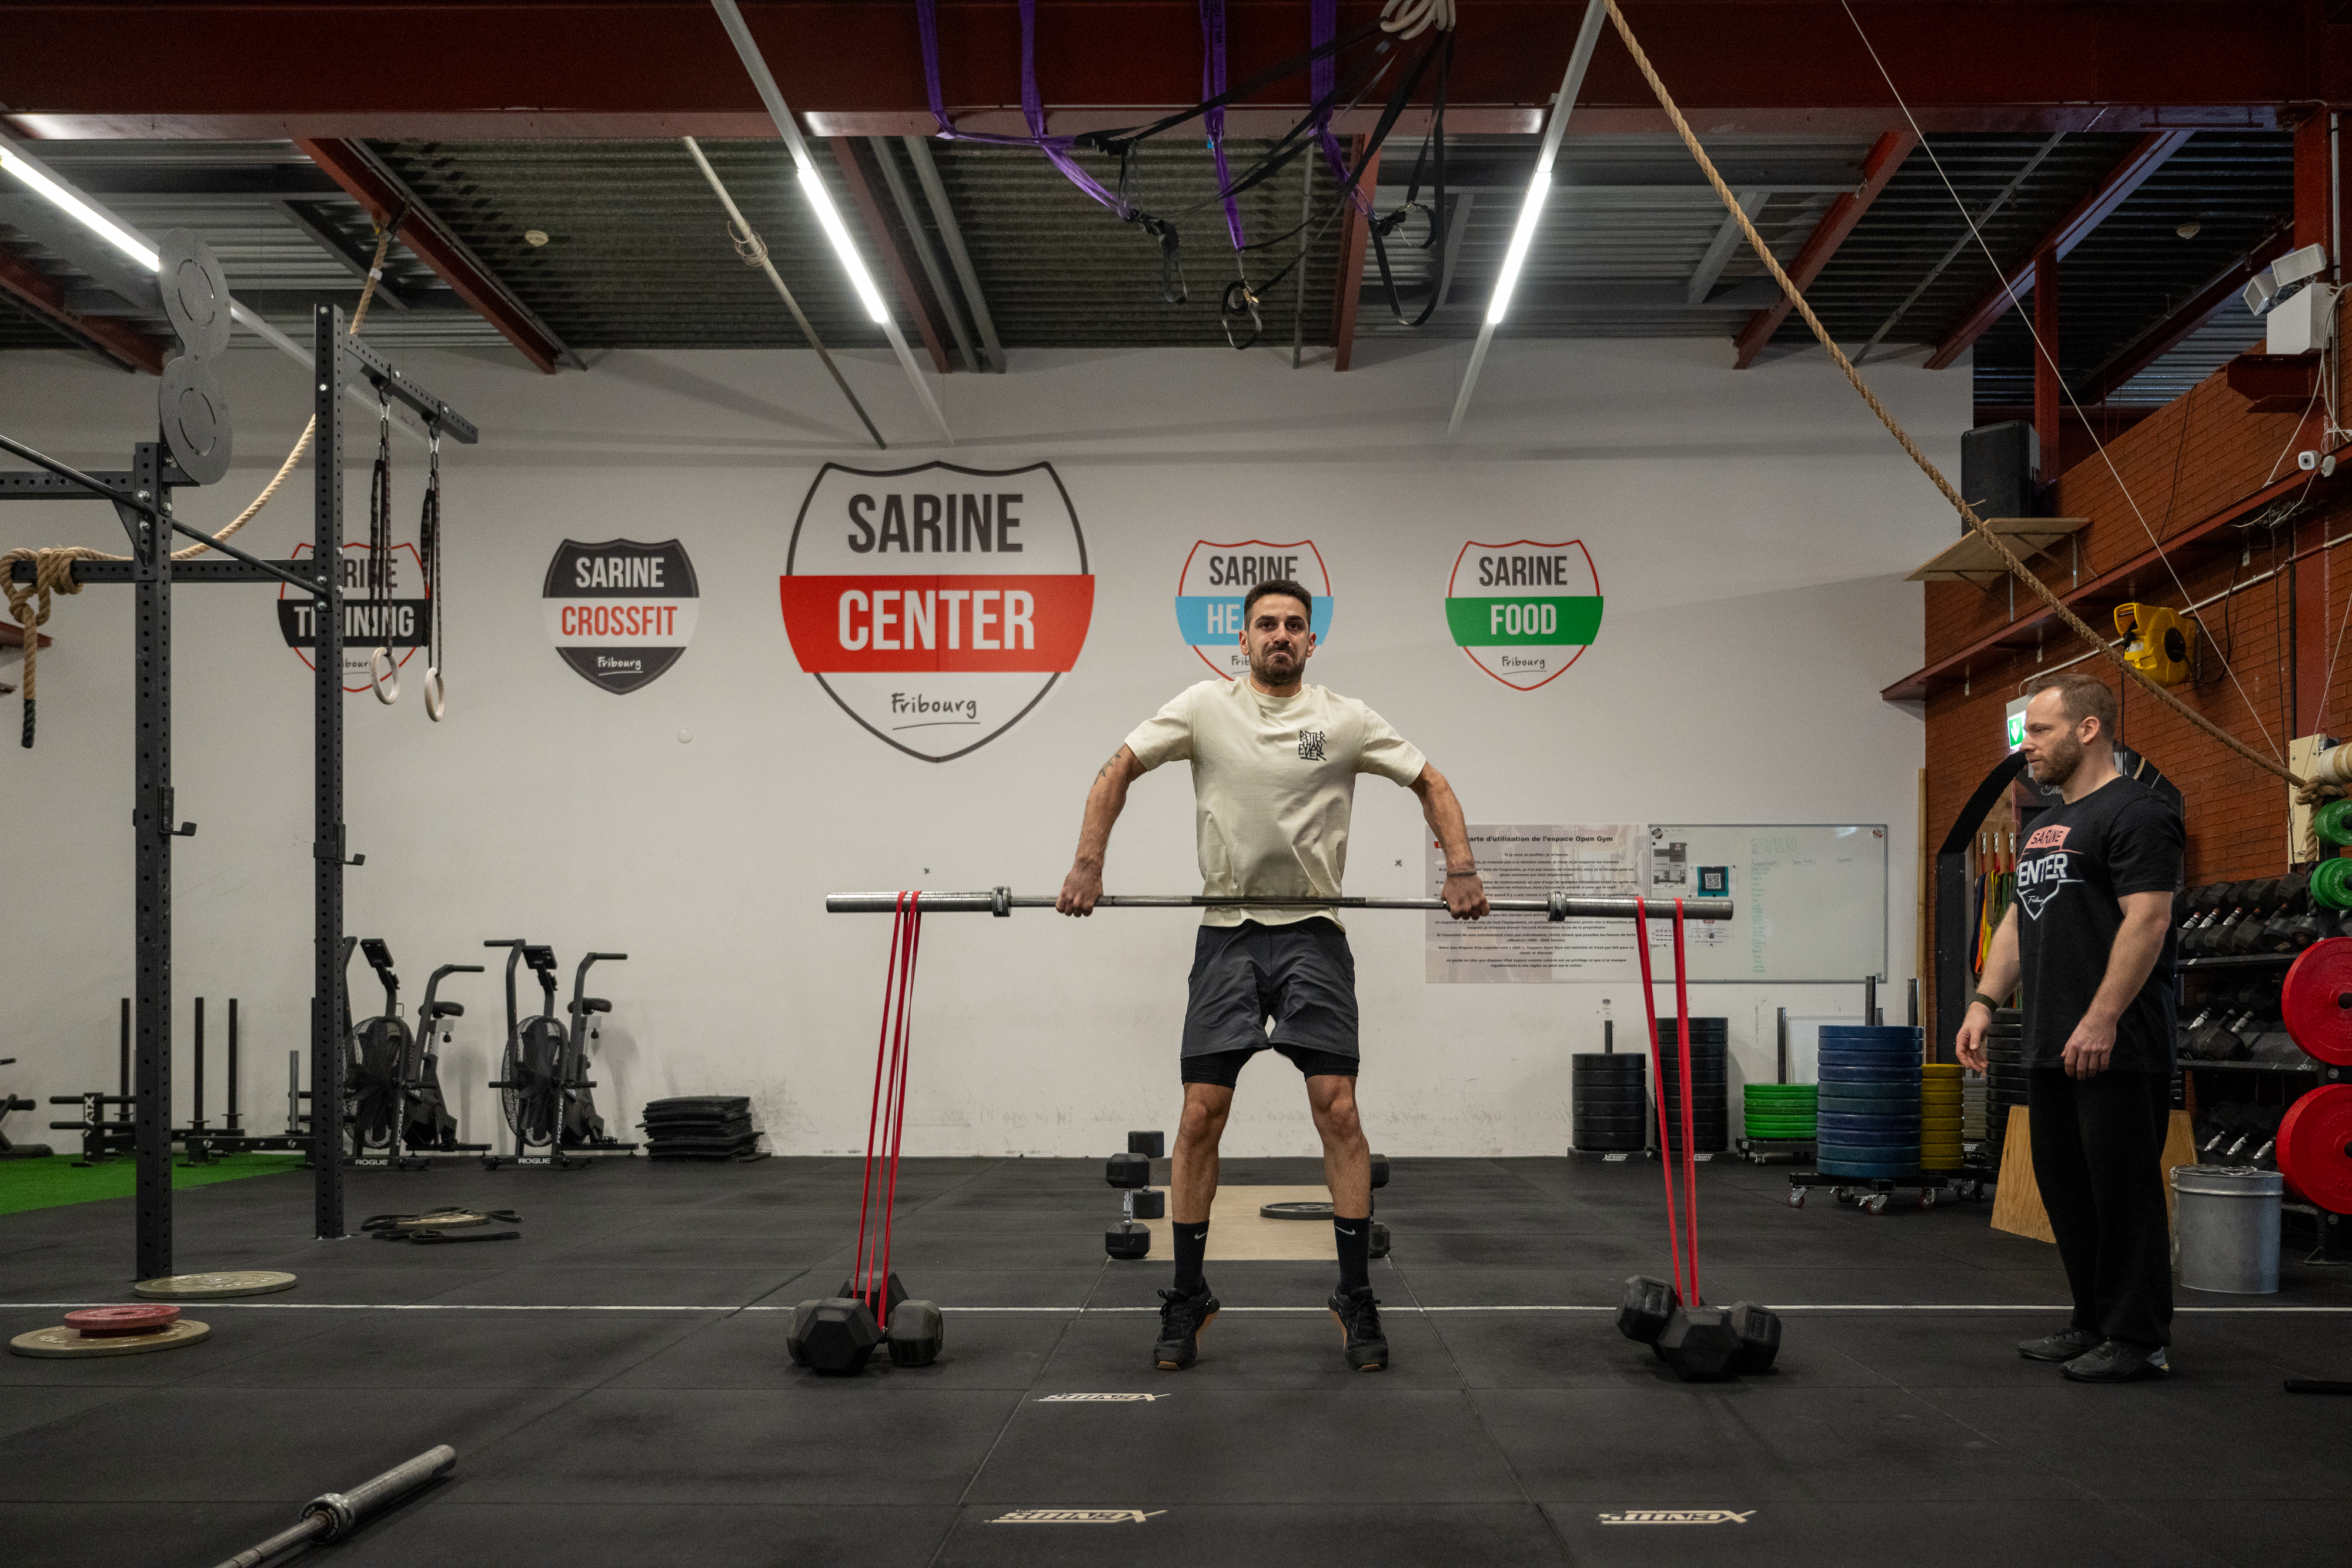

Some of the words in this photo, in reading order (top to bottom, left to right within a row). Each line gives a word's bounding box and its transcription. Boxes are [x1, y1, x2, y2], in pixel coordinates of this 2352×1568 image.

[848, 494, 1023, 554] SARINE
[576, 557, 664, 588] SARINE
[1210, 556, 1298, 586] SARINE
[1479, 556, 1567, 587] SARINE
[294, 606, 415, 637] TINING
[562, 606, 678, 636] CROSSFIT
[838, 590, 1035, 651] CENTER
[1491, 604, 1556, 635] FOOD
[597, 656, 643, 671] Fribourg
[1502, 656, 1545, 669] Fribourg
[891, 692, 977, 719] Fribourg
[1299, 730, 1327, 744] BETTER
[2030, 829, 2063, 844] SARINE
[396, 1099, 405, 1146] ROGUE
